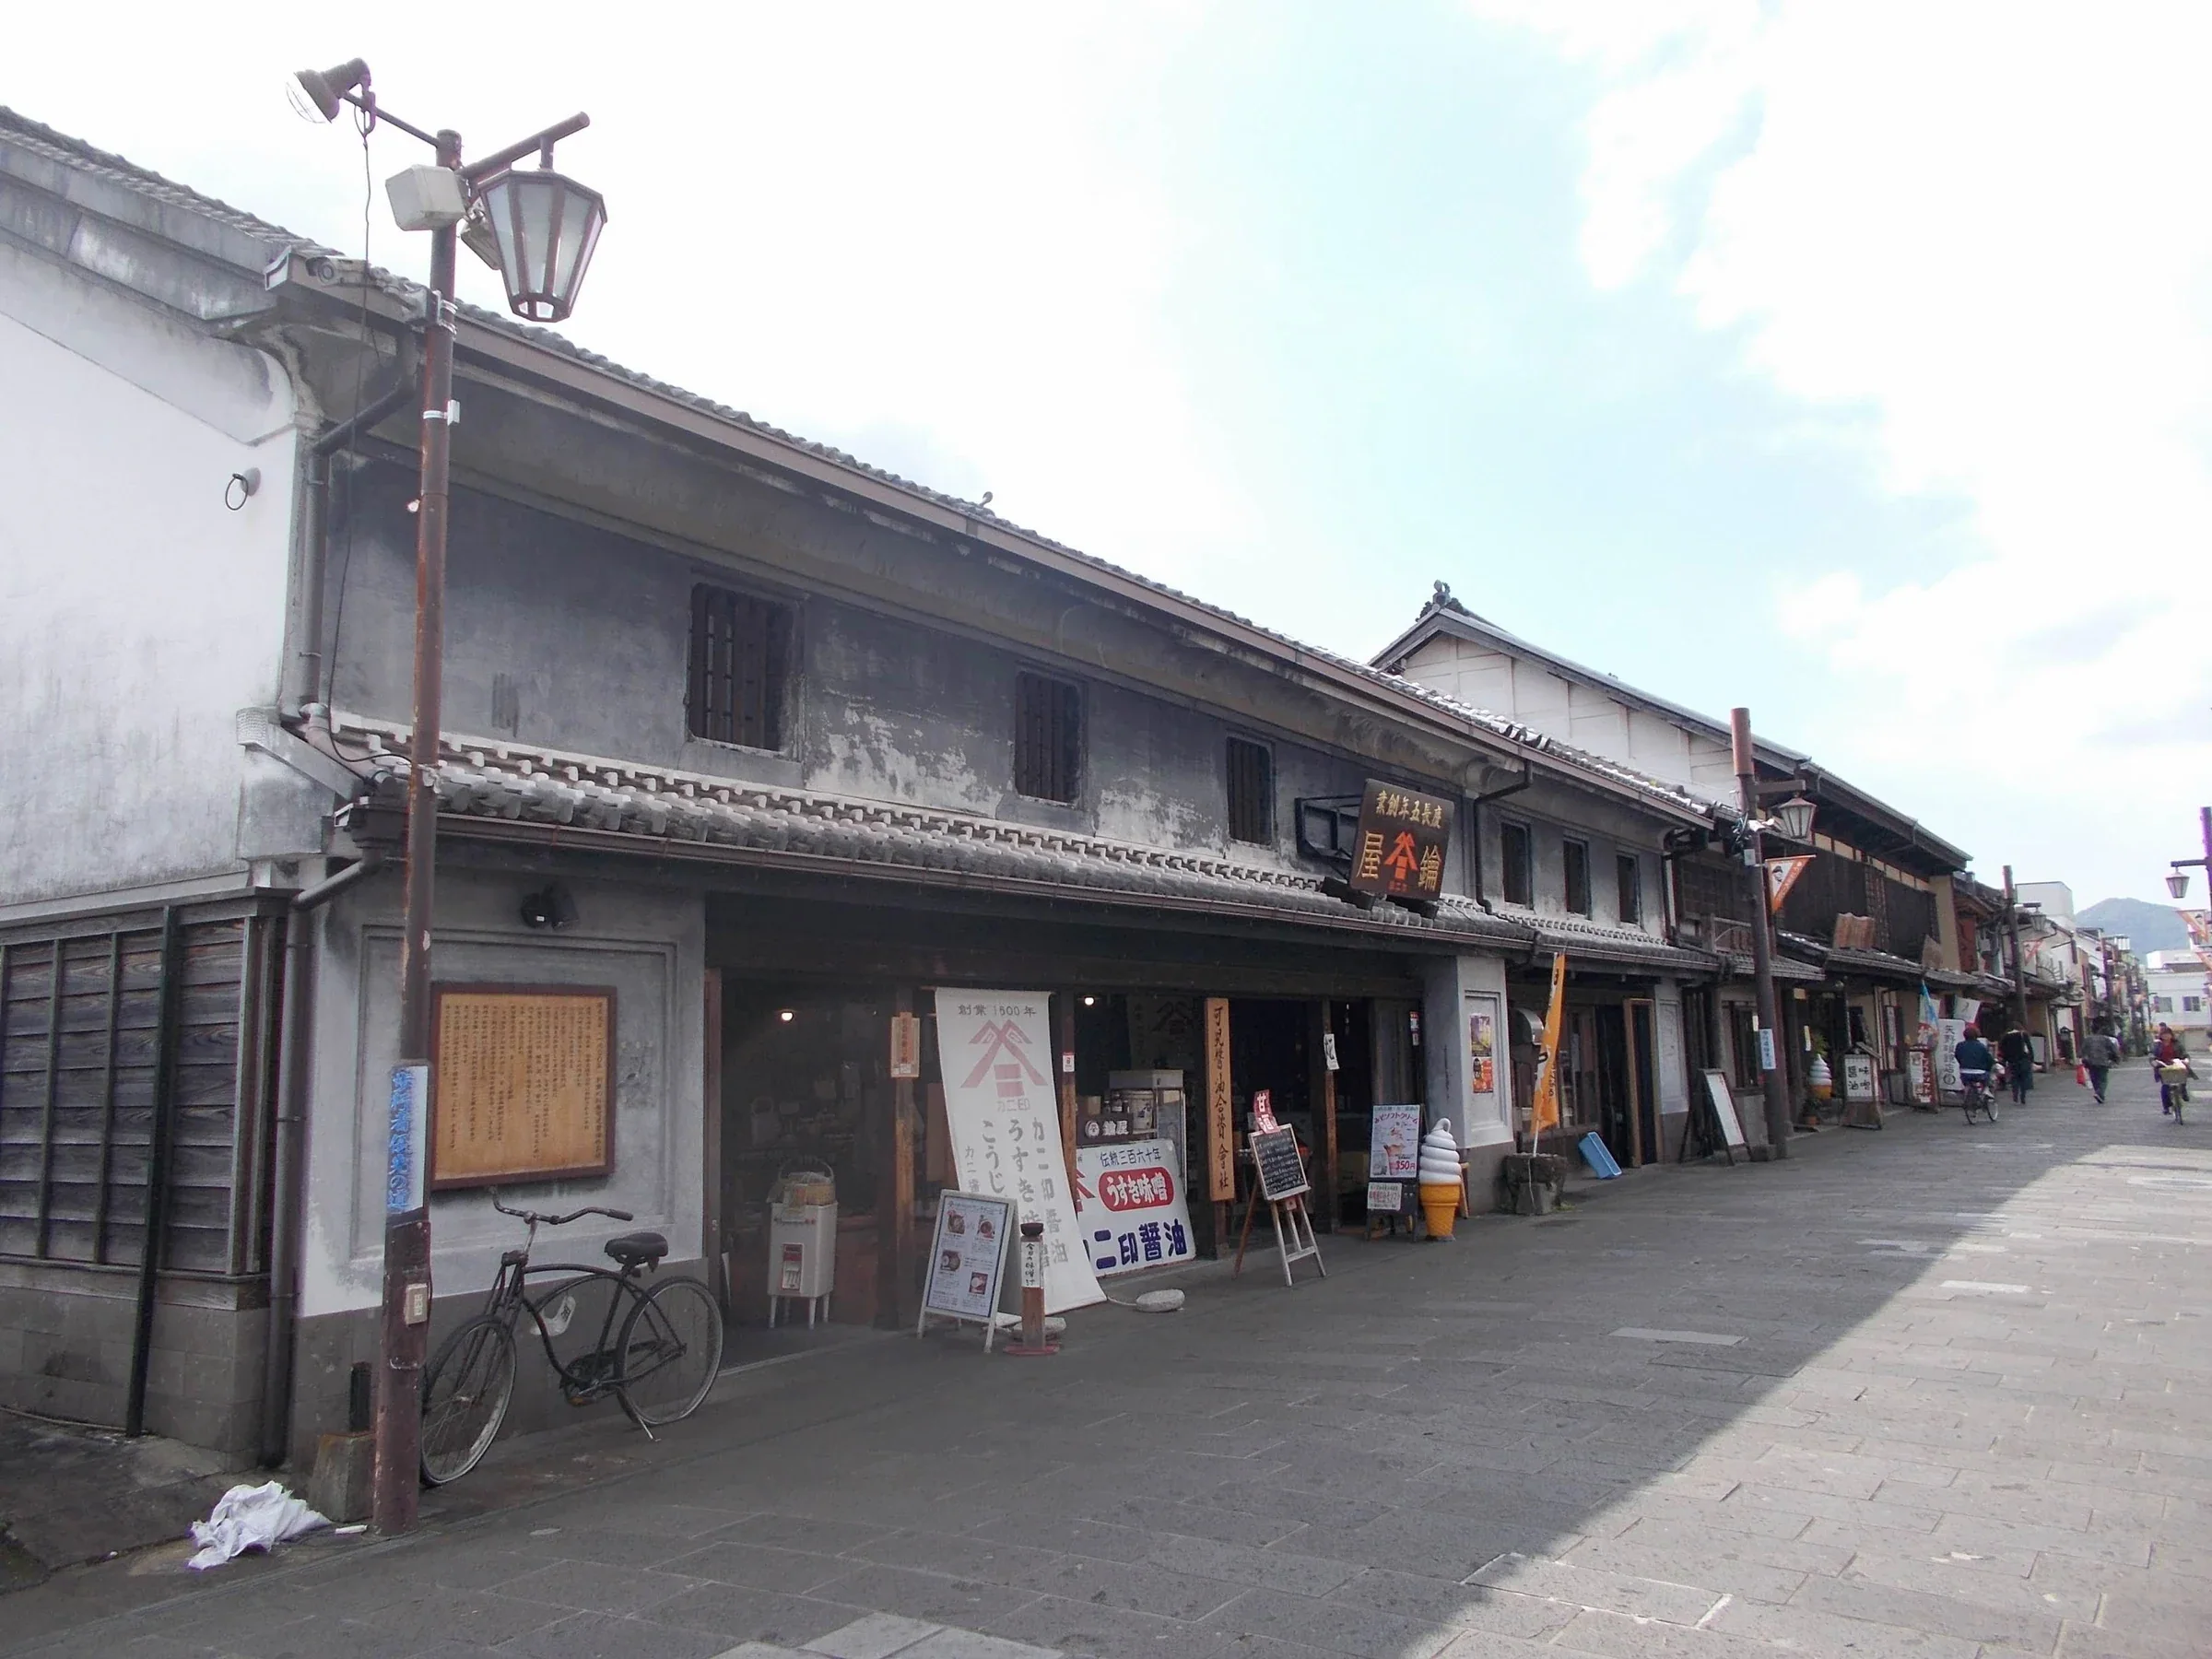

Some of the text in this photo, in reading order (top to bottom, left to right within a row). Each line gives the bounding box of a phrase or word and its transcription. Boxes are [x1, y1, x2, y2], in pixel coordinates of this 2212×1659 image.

[982, 1119, 1006, 1196] こうじ
[1100, 1147, 1162, 1167] 伝統三百六十年
[1106, 1171, 1168, 1206] うすき味噌
[1083, 1218, 1187, 1270] ニ印醤油
